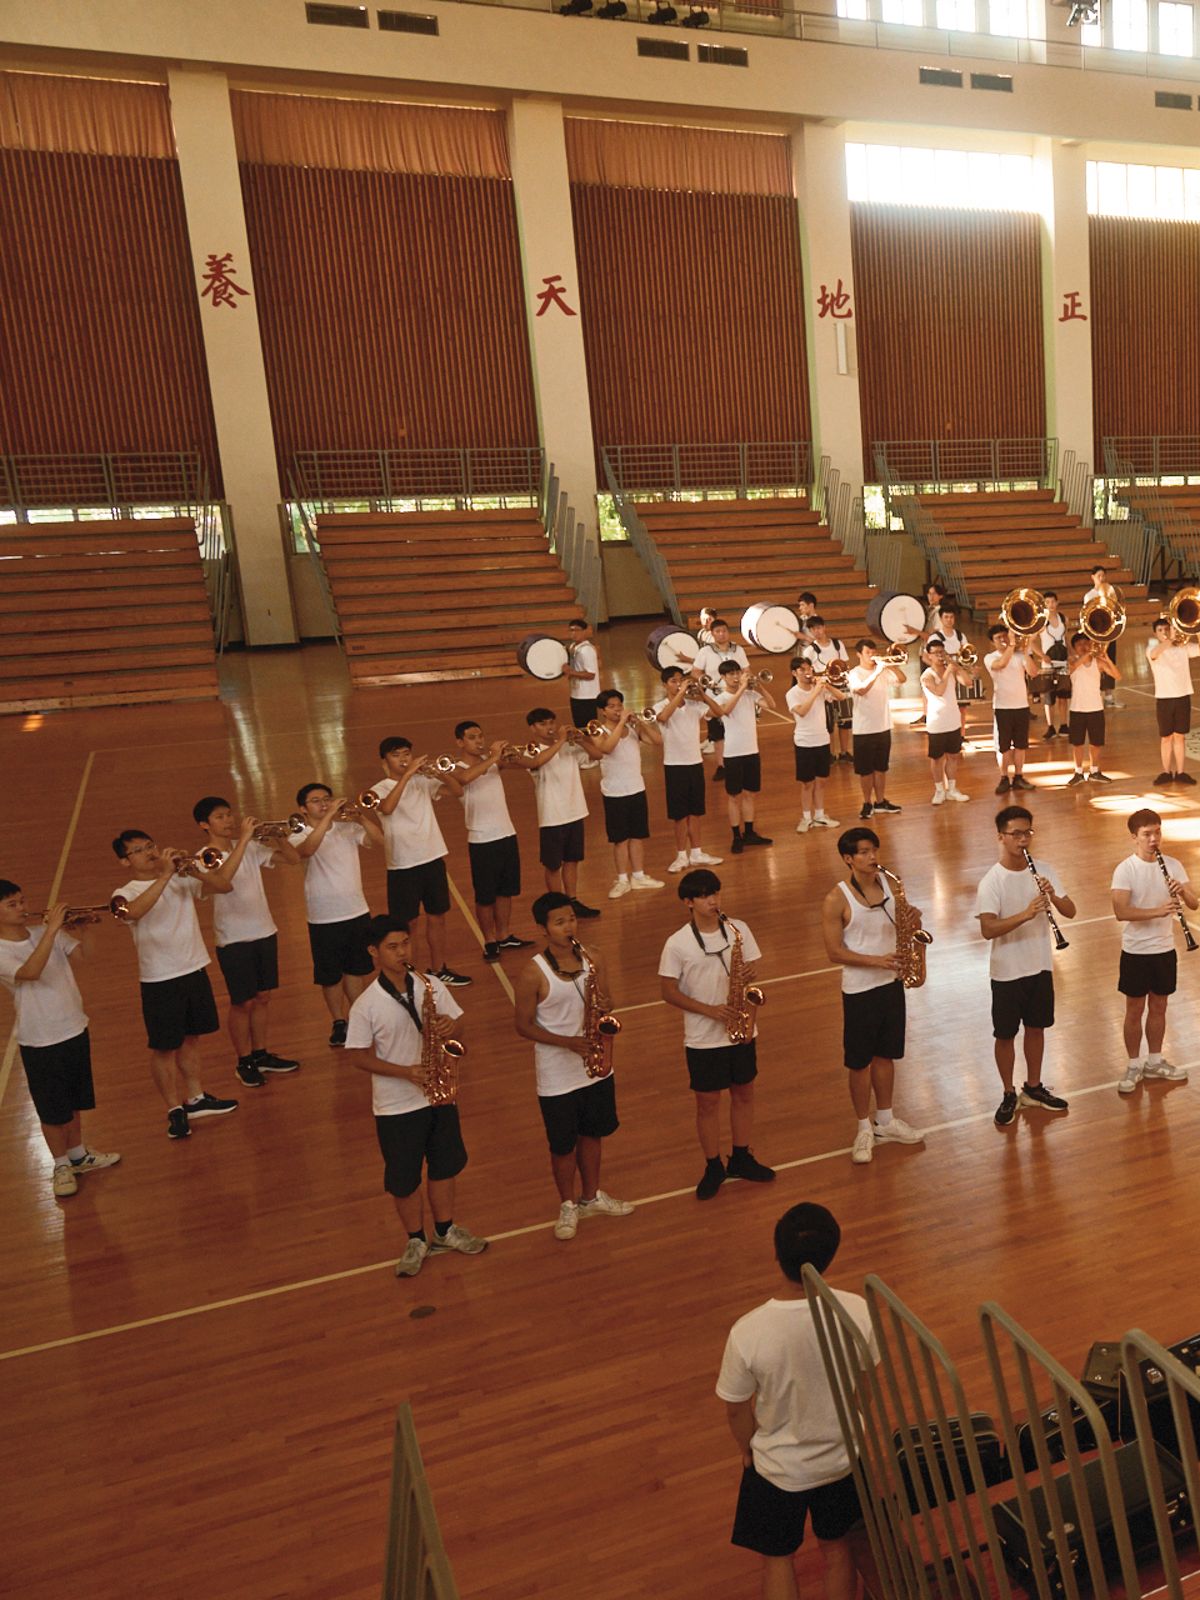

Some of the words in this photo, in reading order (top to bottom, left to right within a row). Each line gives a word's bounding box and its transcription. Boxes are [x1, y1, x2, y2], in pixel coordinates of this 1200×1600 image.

[201, 252, 250, 309] 養
[535, 275, 577, 317] 天
[816, 279, 853, 320] 地
[1058, 291, 1088, 322] 正
